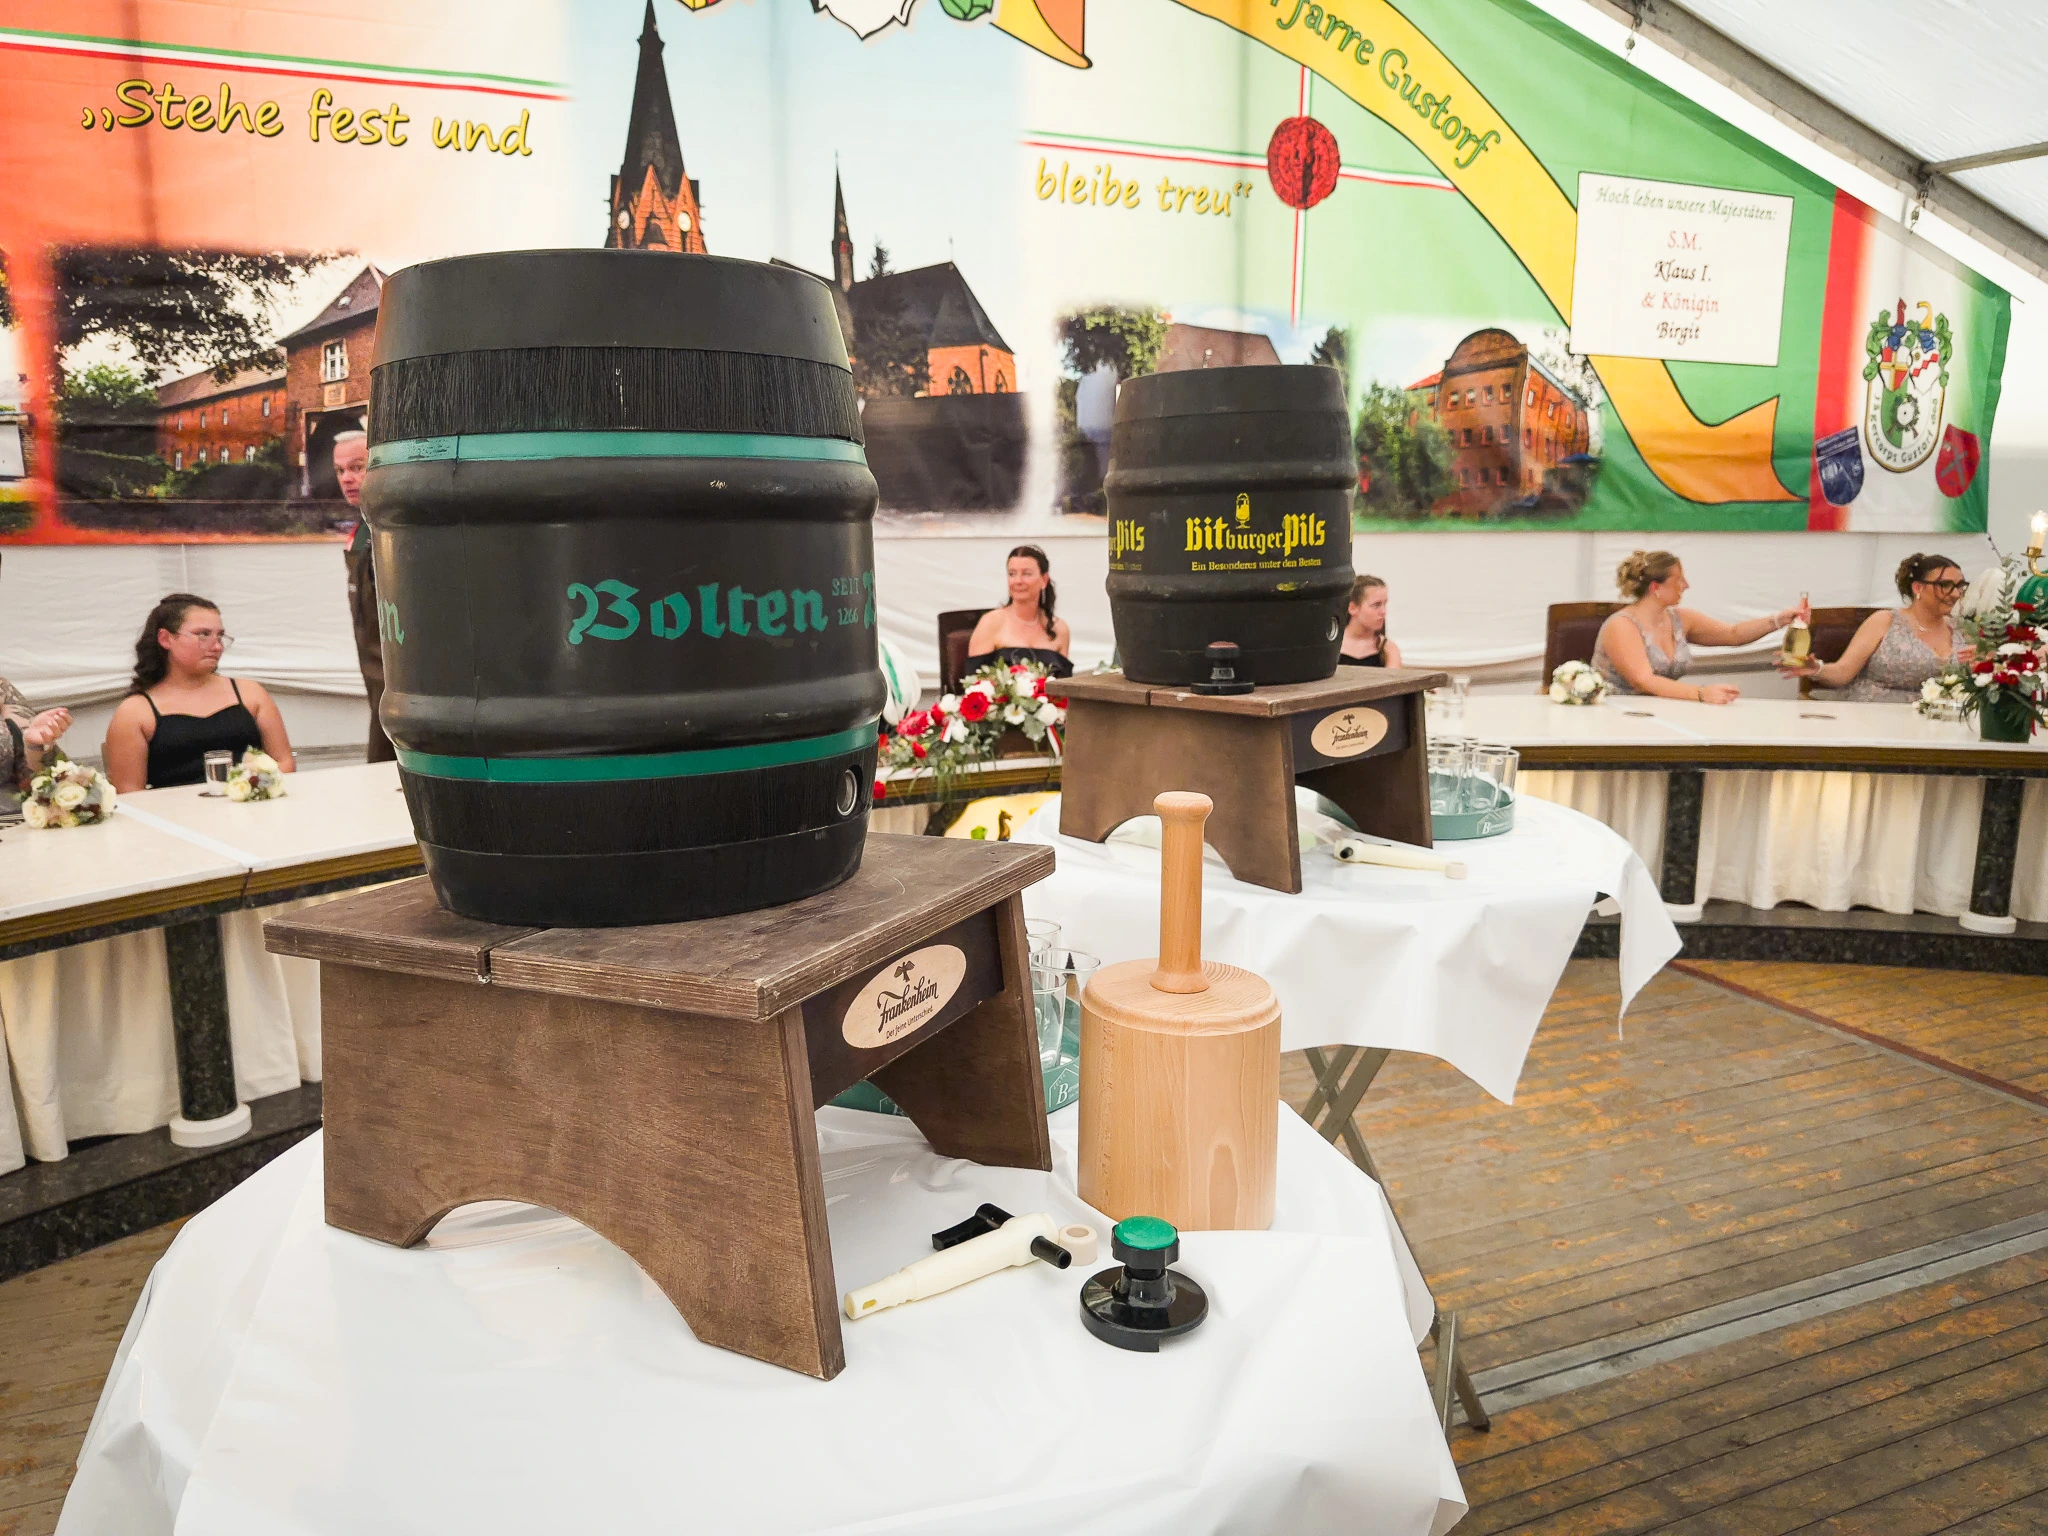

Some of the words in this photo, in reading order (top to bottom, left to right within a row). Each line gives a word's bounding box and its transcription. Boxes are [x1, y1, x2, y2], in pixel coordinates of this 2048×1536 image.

[307, 88, 410, 147] fest
[432, 108, 533, 157] und
[1379, 48, 1501, 170] Gustorf
[1035, 157, 1140, 209] bleibe
[1596, 186, 1630, 205] Hoch
[1632, 188, 1664, 209] leben
[1667, 196, 1706, 214] unsere
[1708, 199, 1777, 223] Majestäten:
[1667, 230, 1702, 251] S.M.
[1653, 259, 1696, 282] Klaus
[1701, 264, 1712, 282] I.
[1641, 291, 1655, 308] &
[1661, 292, 1720, 320] Königin
[1656, 321, 1701, 346] Birgit
[1191, 561, 1207, 571] Ein
[1208, 560, 1257, 571] Besonderes
[1259, 559, 1281, 569] unter
[1282, 558, 1297, 568] den
[1298, 557, 1322, 568] Besten
[831, 576, 860, 596] SEIT
[566, 578, 828, 645] Bolten
[877, 976, 939, 1034] Frankenheim
[886, 1029, 895, 1039] Der
